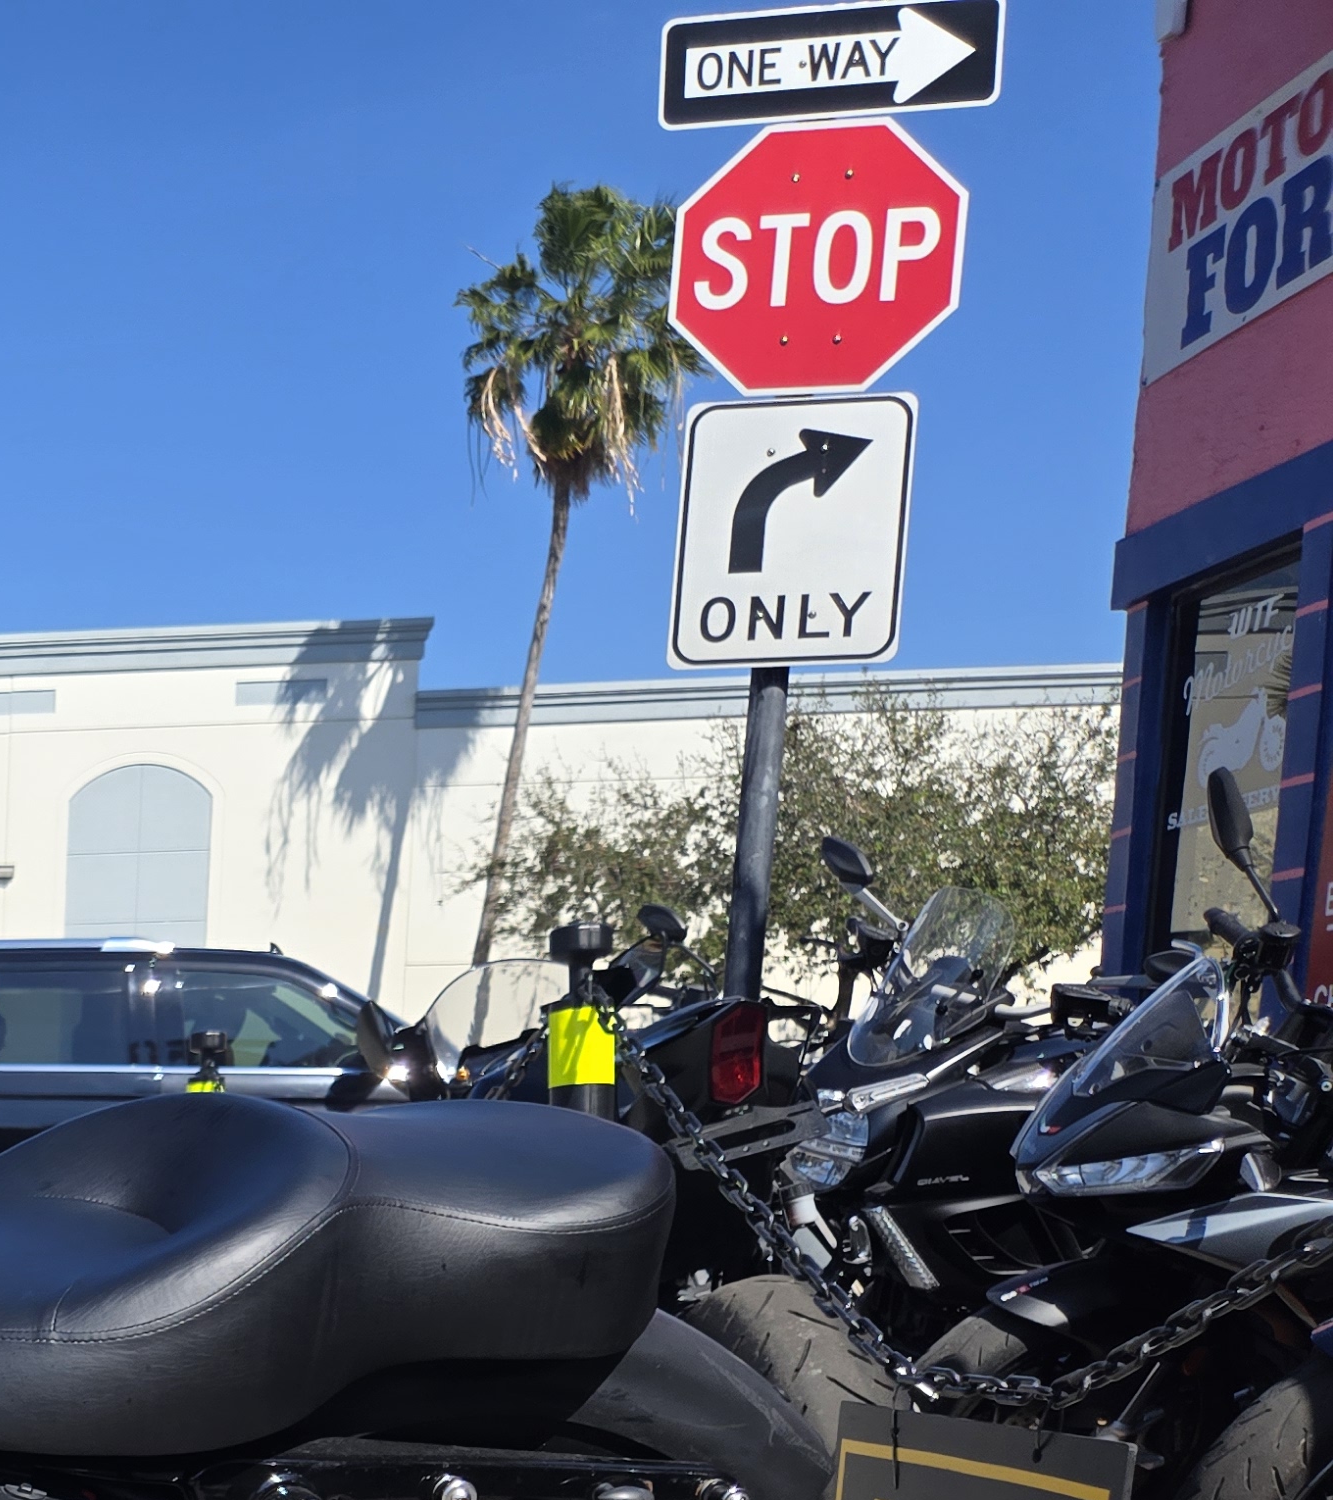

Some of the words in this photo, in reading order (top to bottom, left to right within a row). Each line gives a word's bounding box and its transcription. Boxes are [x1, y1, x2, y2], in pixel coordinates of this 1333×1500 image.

[696, 47, 782, 92] ONE
[808, 36, 900, 82] WAY
[693, 206, 942, 311] STOP
[1181, 154, 1333, 350] FOR
[700, 591, 873, 643] ONLY
[1166, 803, 1209, 831] SALE
